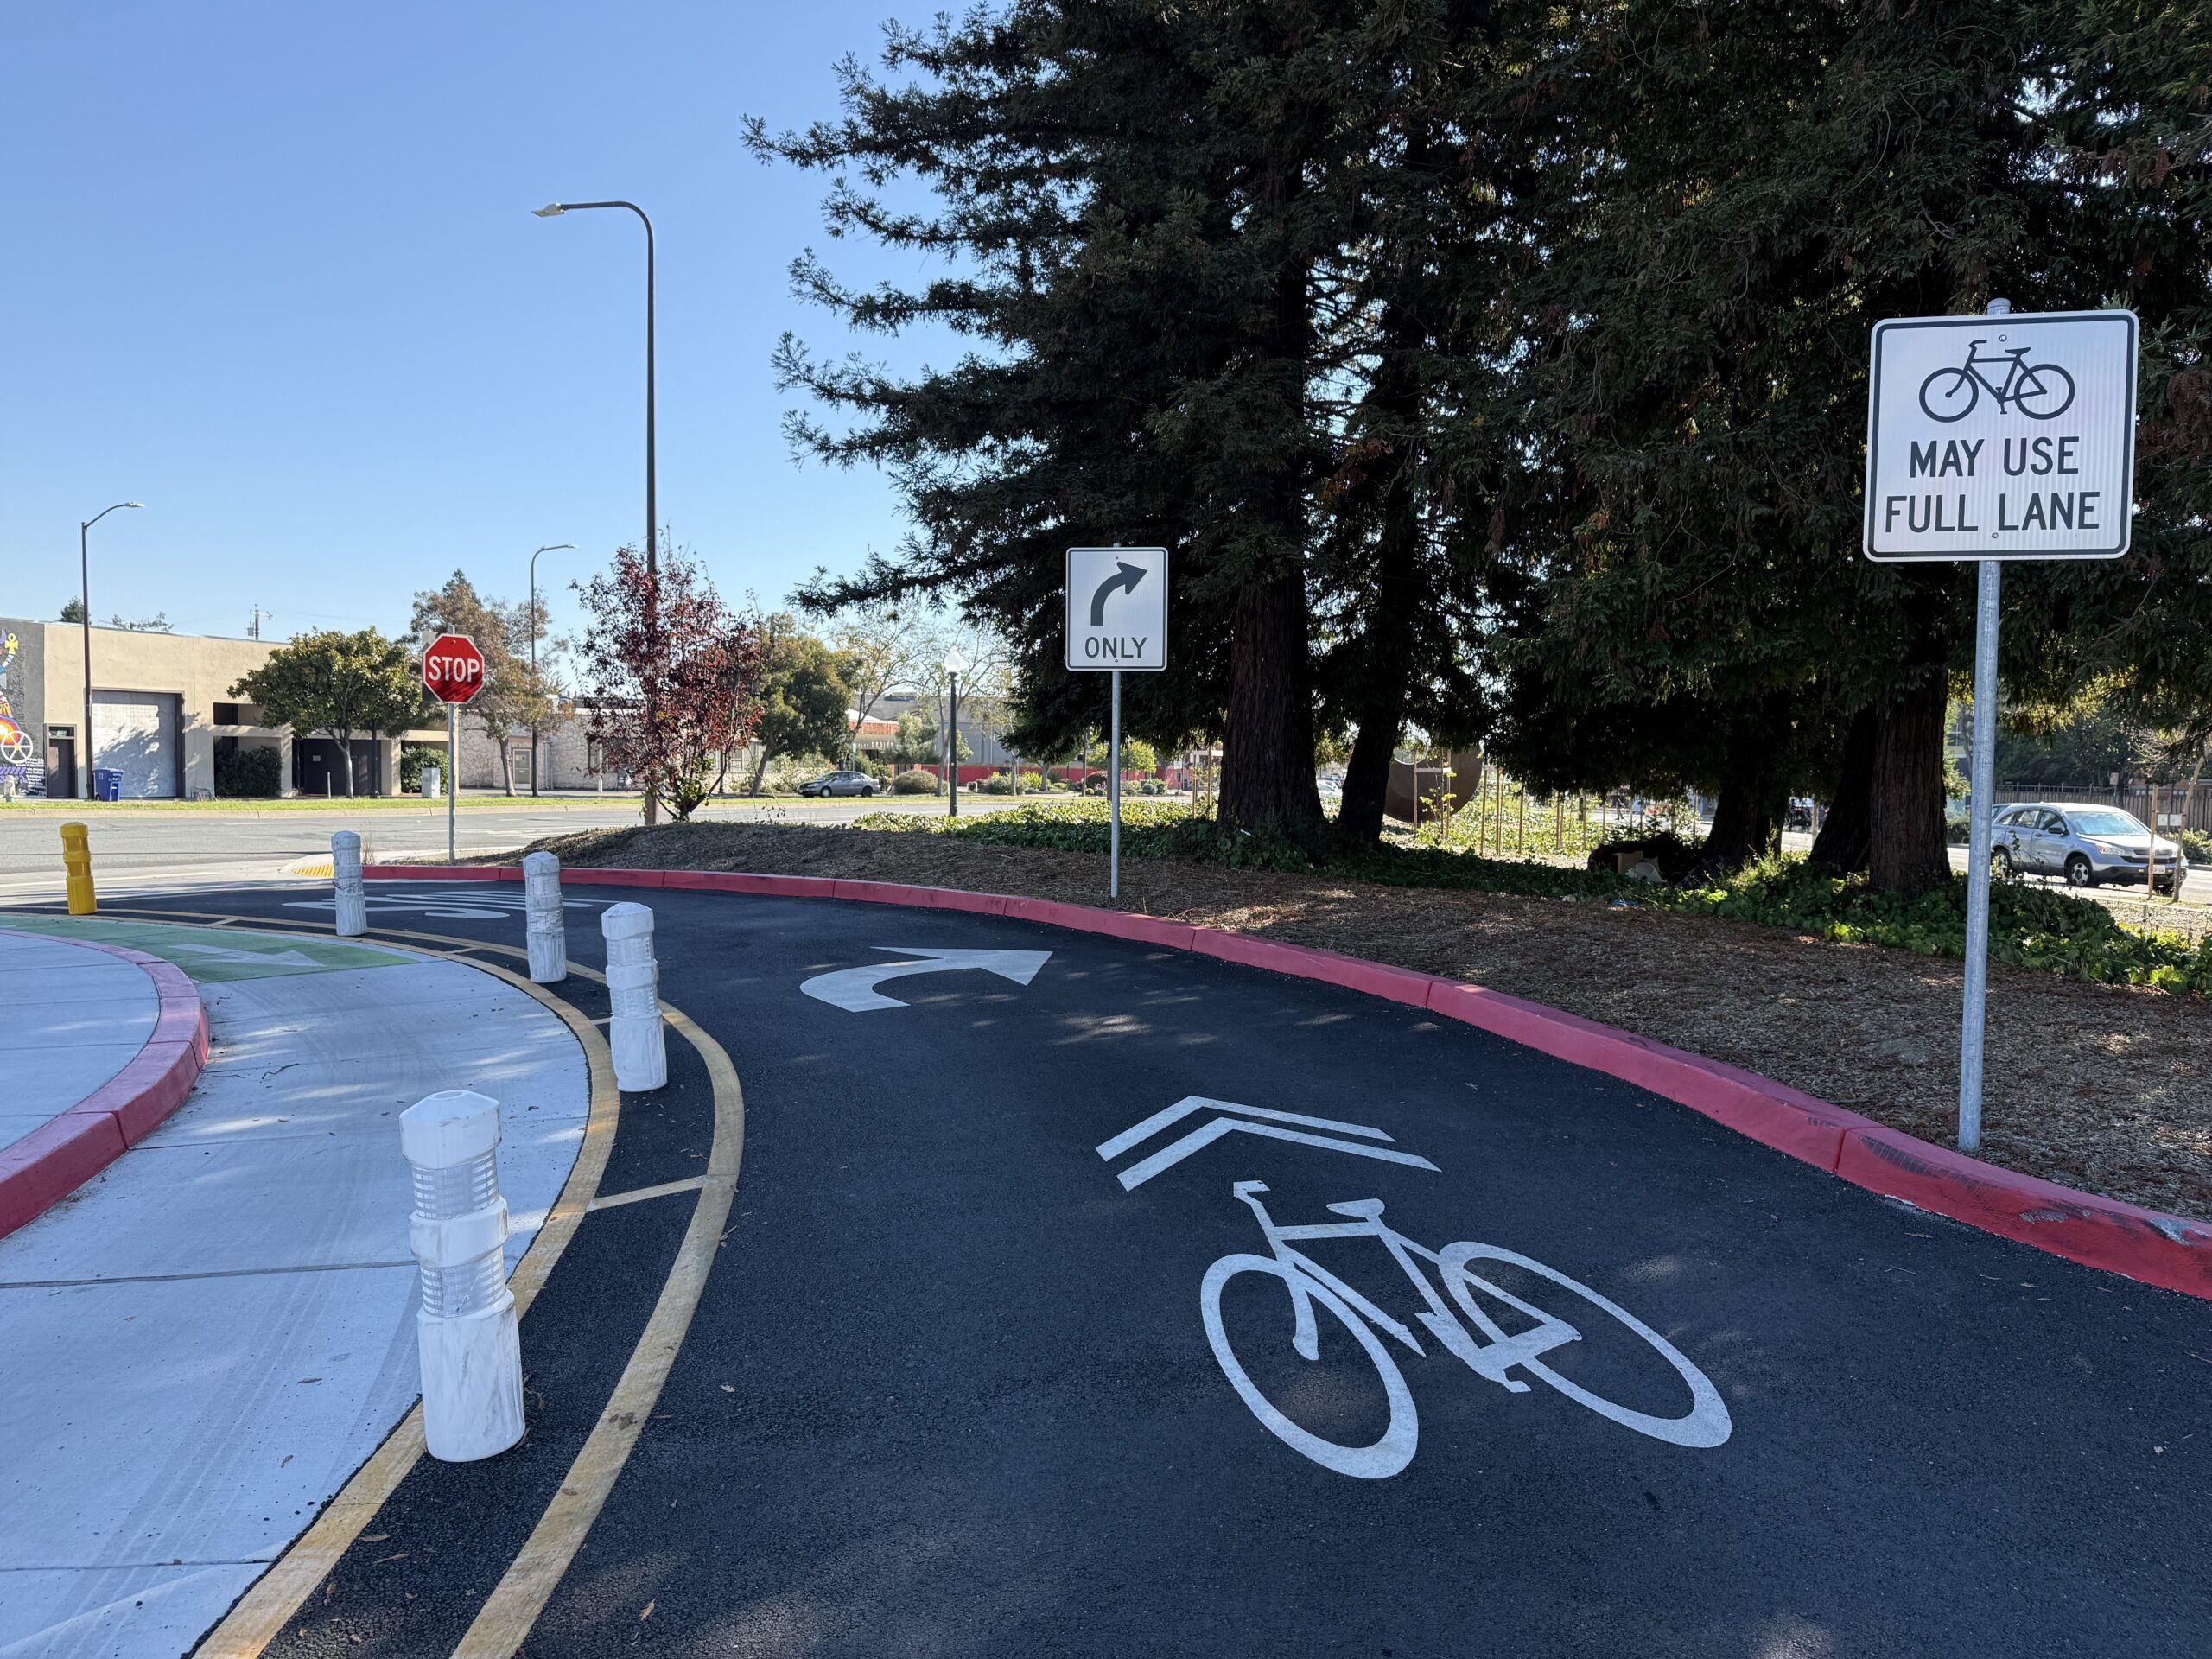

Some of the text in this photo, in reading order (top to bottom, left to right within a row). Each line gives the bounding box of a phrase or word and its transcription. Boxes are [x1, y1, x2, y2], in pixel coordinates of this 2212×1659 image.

[1909, 436, 2080, 478] MAY USE
[1885, 491, 2101, 533] FULL LANE
[1084, 636, 1148, 658] ONLY
[428, 655, 480, 683] STOP
